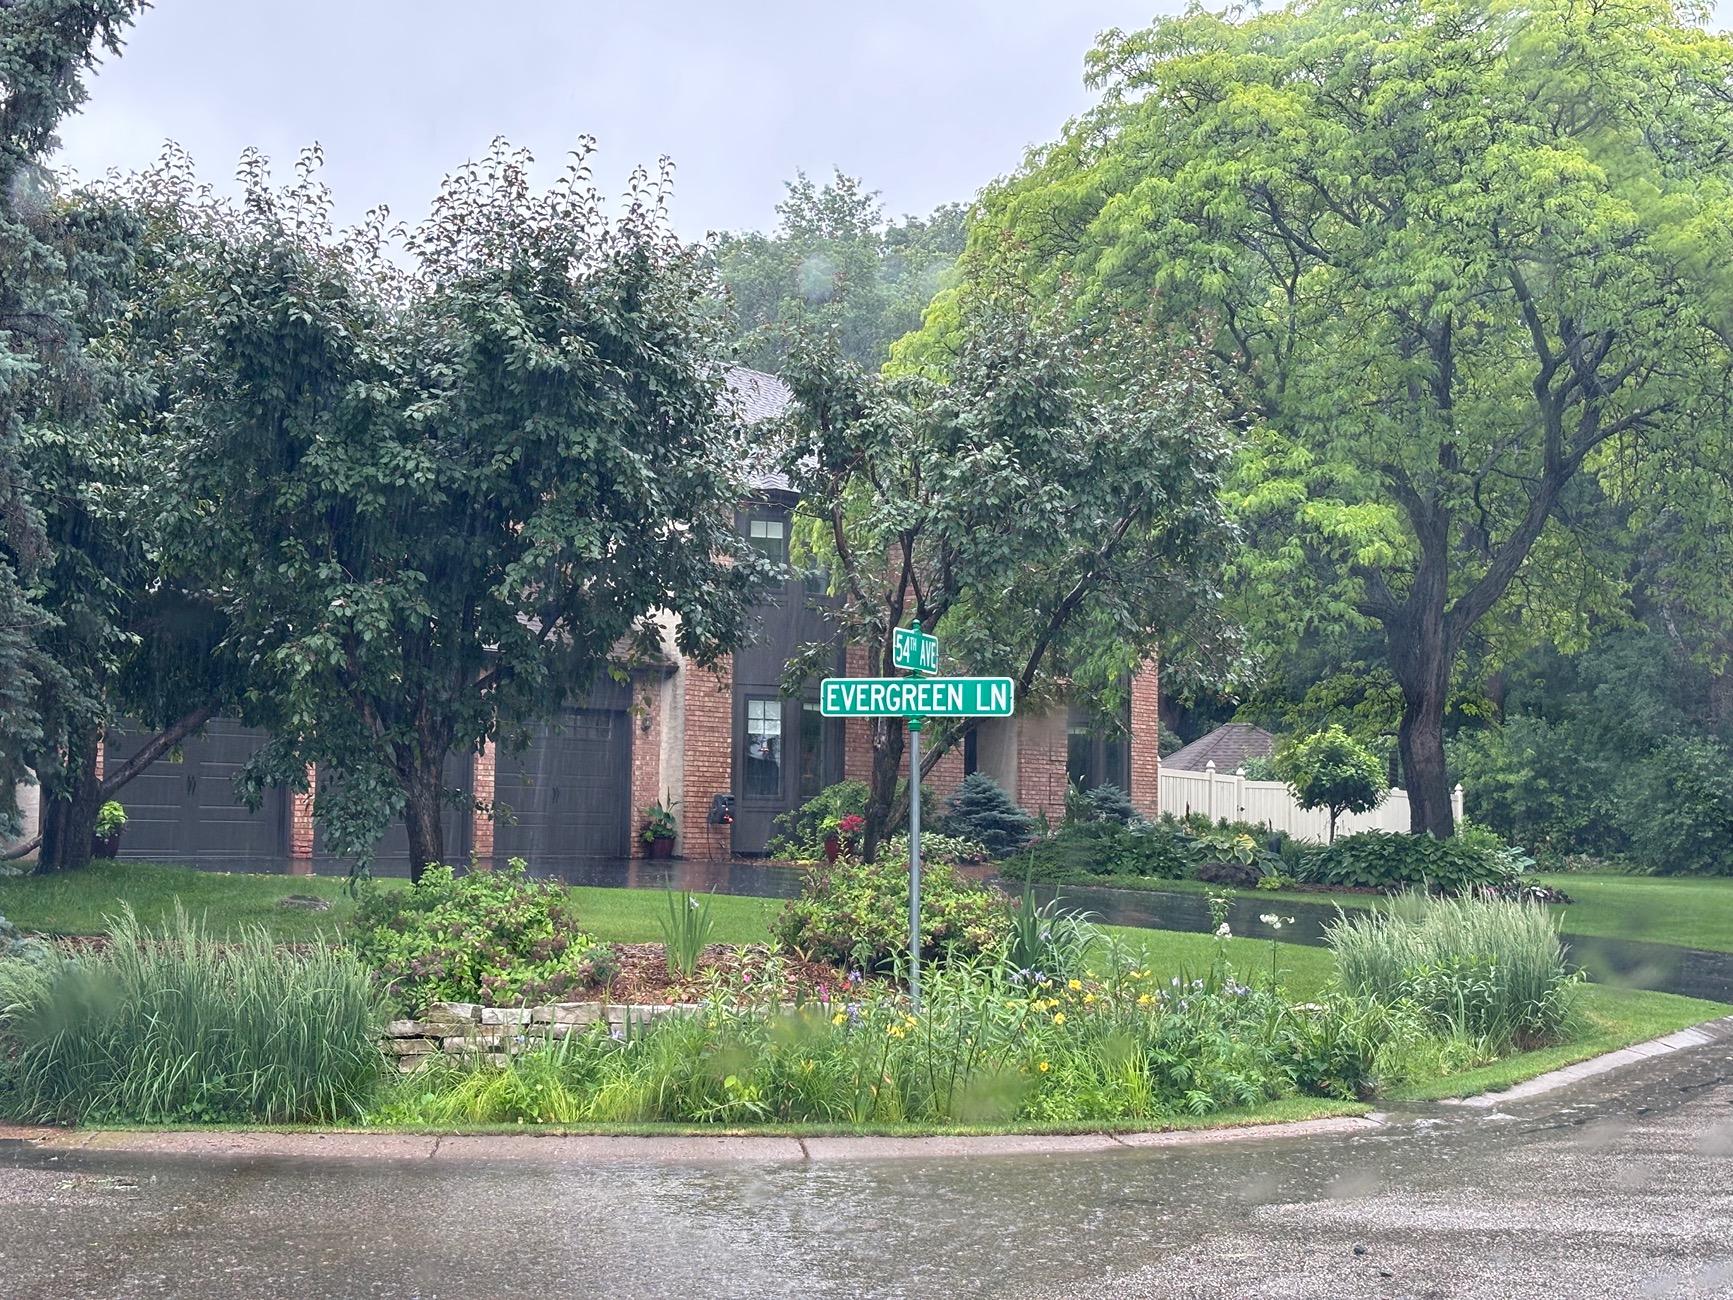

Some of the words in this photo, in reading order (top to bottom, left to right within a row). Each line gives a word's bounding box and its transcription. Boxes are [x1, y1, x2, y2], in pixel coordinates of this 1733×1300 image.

[896, 634, 917, 663] 54TH
[920, 640, 936, 669] AVE
[826, 683, 963, 711] EVERGREEN
[976, 683, 1007, 711] LN
